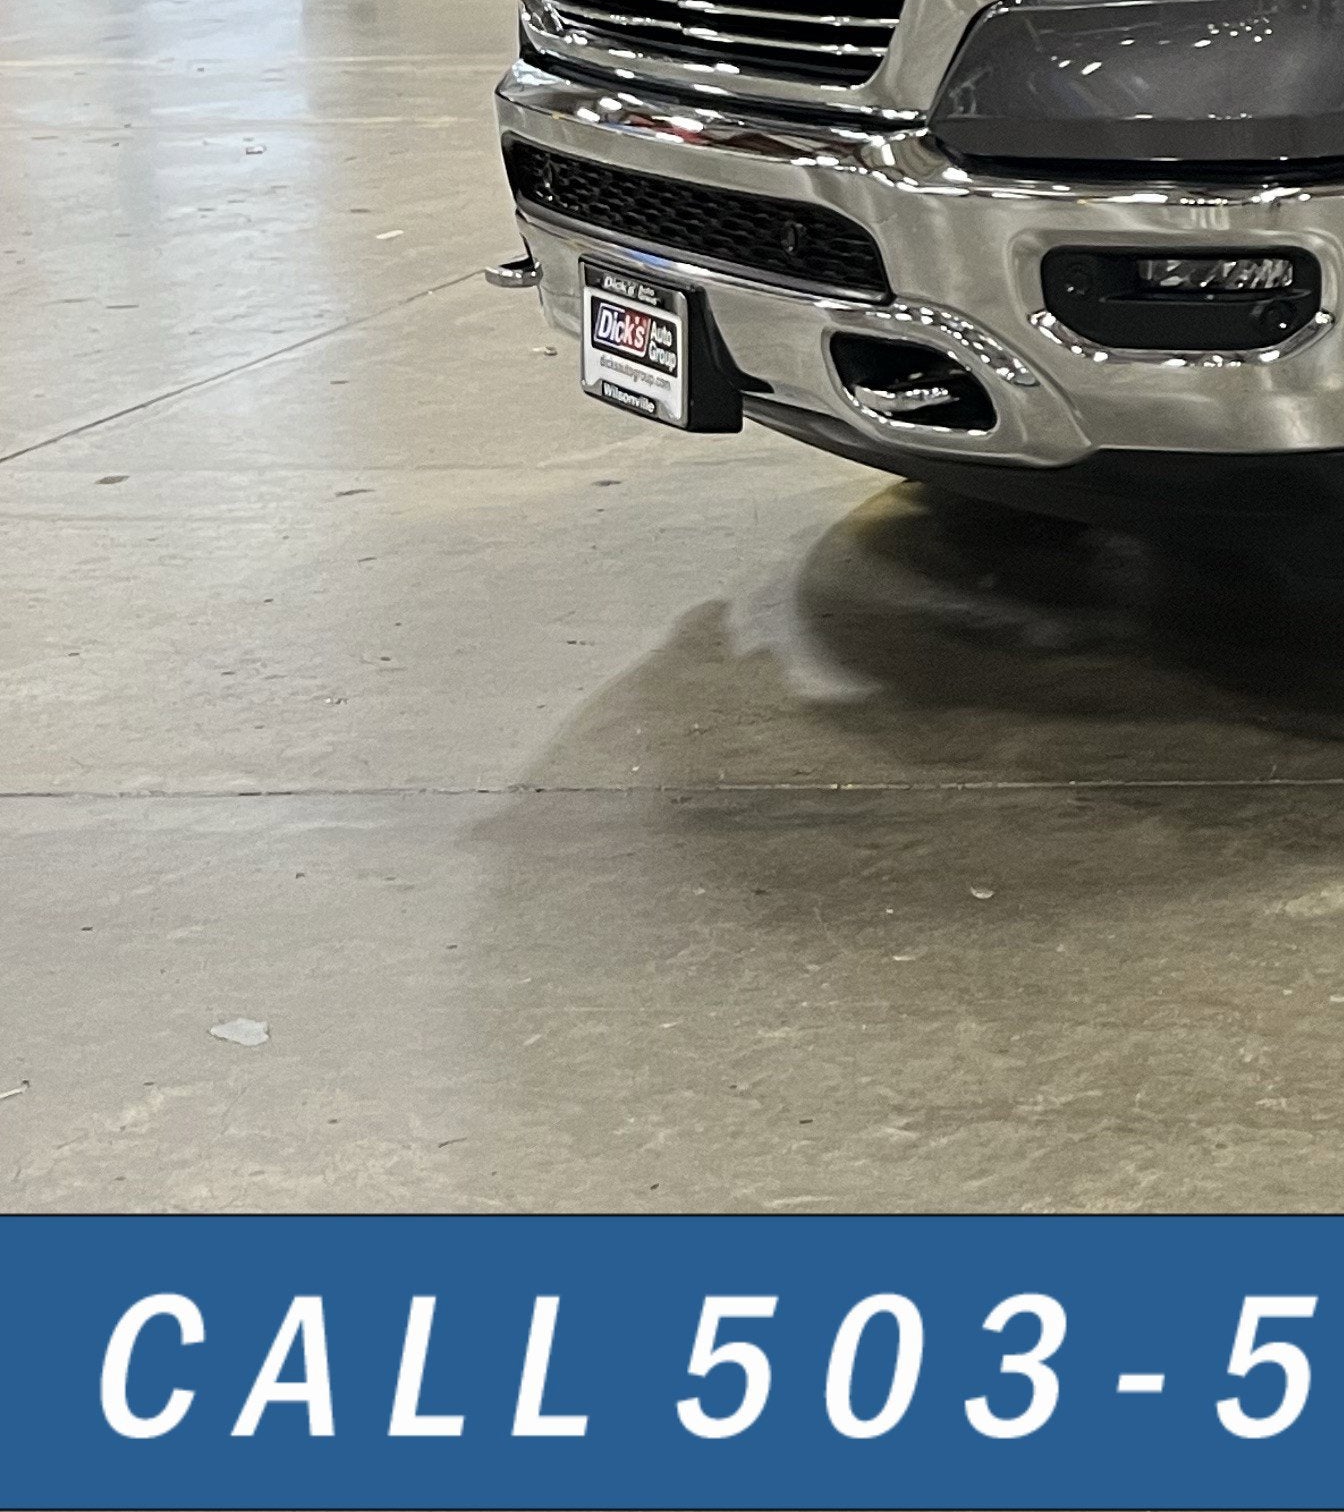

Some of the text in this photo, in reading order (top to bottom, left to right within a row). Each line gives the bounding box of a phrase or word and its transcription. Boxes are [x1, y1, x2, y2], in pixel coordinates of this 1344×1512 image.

[598, 308, 646, 351] Dick's
[651, 320, 673, 347] Auto
[649, 341, 677, 373] Group
[604, 382, 655, 414] Wilsonville
